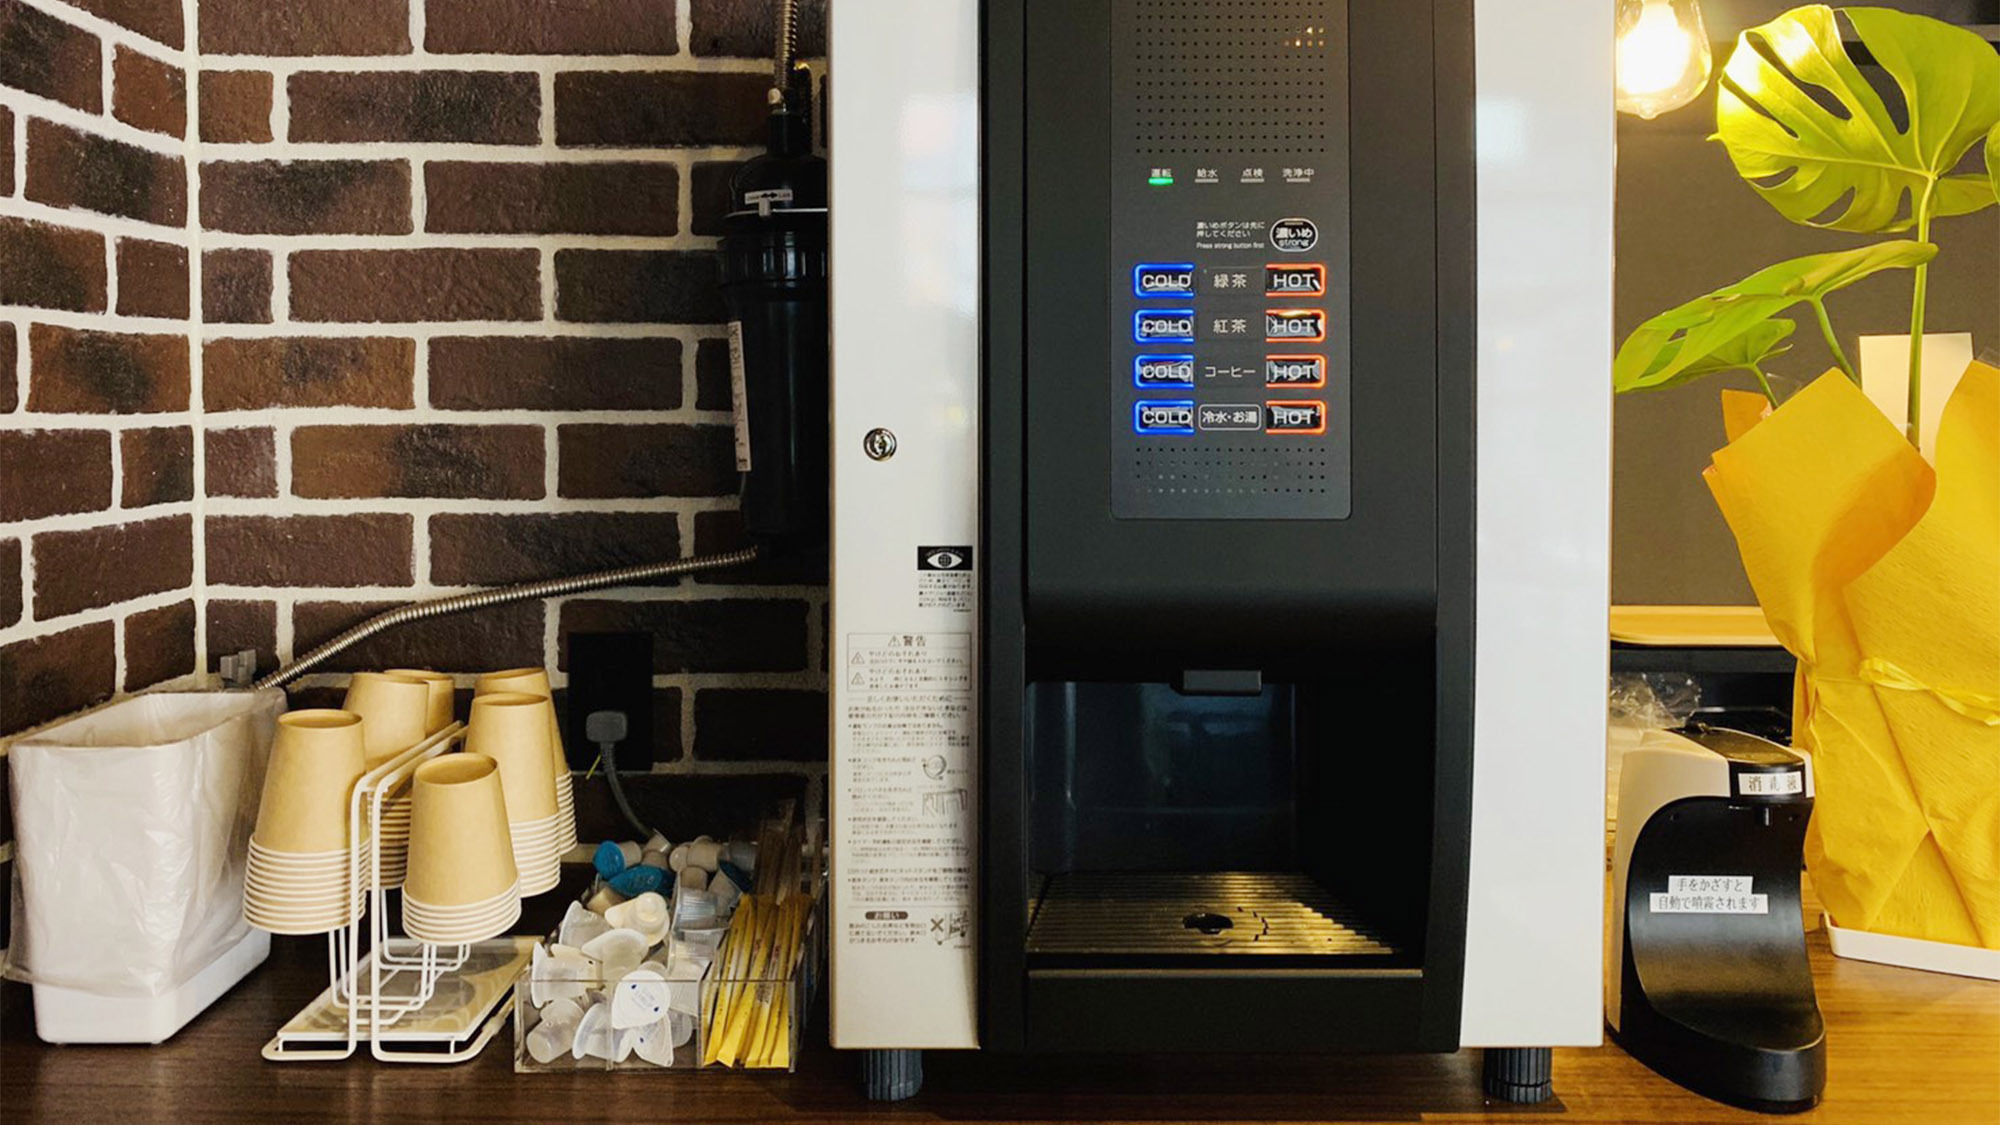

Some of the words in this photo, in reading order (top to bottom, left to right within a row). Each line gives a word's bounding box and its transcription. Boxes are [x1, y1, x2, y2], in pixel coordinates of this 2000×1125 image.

[1151, 168, 1172, 177] 運転
[1196, 168, 1218, 177] 給水
[1242, 168, 1264, 177] 点検
[1282, 168, 1315, 177] 洗浄中
[1196, 221, 1265, 230] 濃いめボタンは先に
[1275, 227, 1313, 238] 濃いめ
[1196, 229, 1251, 238] 押してください
[1214, 242, 1233, 250] strong
[1278, 238, 1310, 247] strong
[1142, 274, 1191, 288] COLD
[1213, 273, 1248, 289] 緑茶
[1273, 274, 1314, 288] HOT
[1142, 319, 1191, 333] COLD
[1213, 319, 1247, 334] 紅茶
[1273, 319, 1314, 333] HOT
[1142, 365, 1191, 379] COLD
[1204, 366, 1257, 378] コーヒー
[1273, 365, 1314, 379] HOT
[1142, 411, 1191, 425] COLD
[1273, 411, 1314, 425] HOT
[1677, 877, 1743, 892] 手をかざすと
[1658, 896, 1761, 911] 自動で噴霧されます
